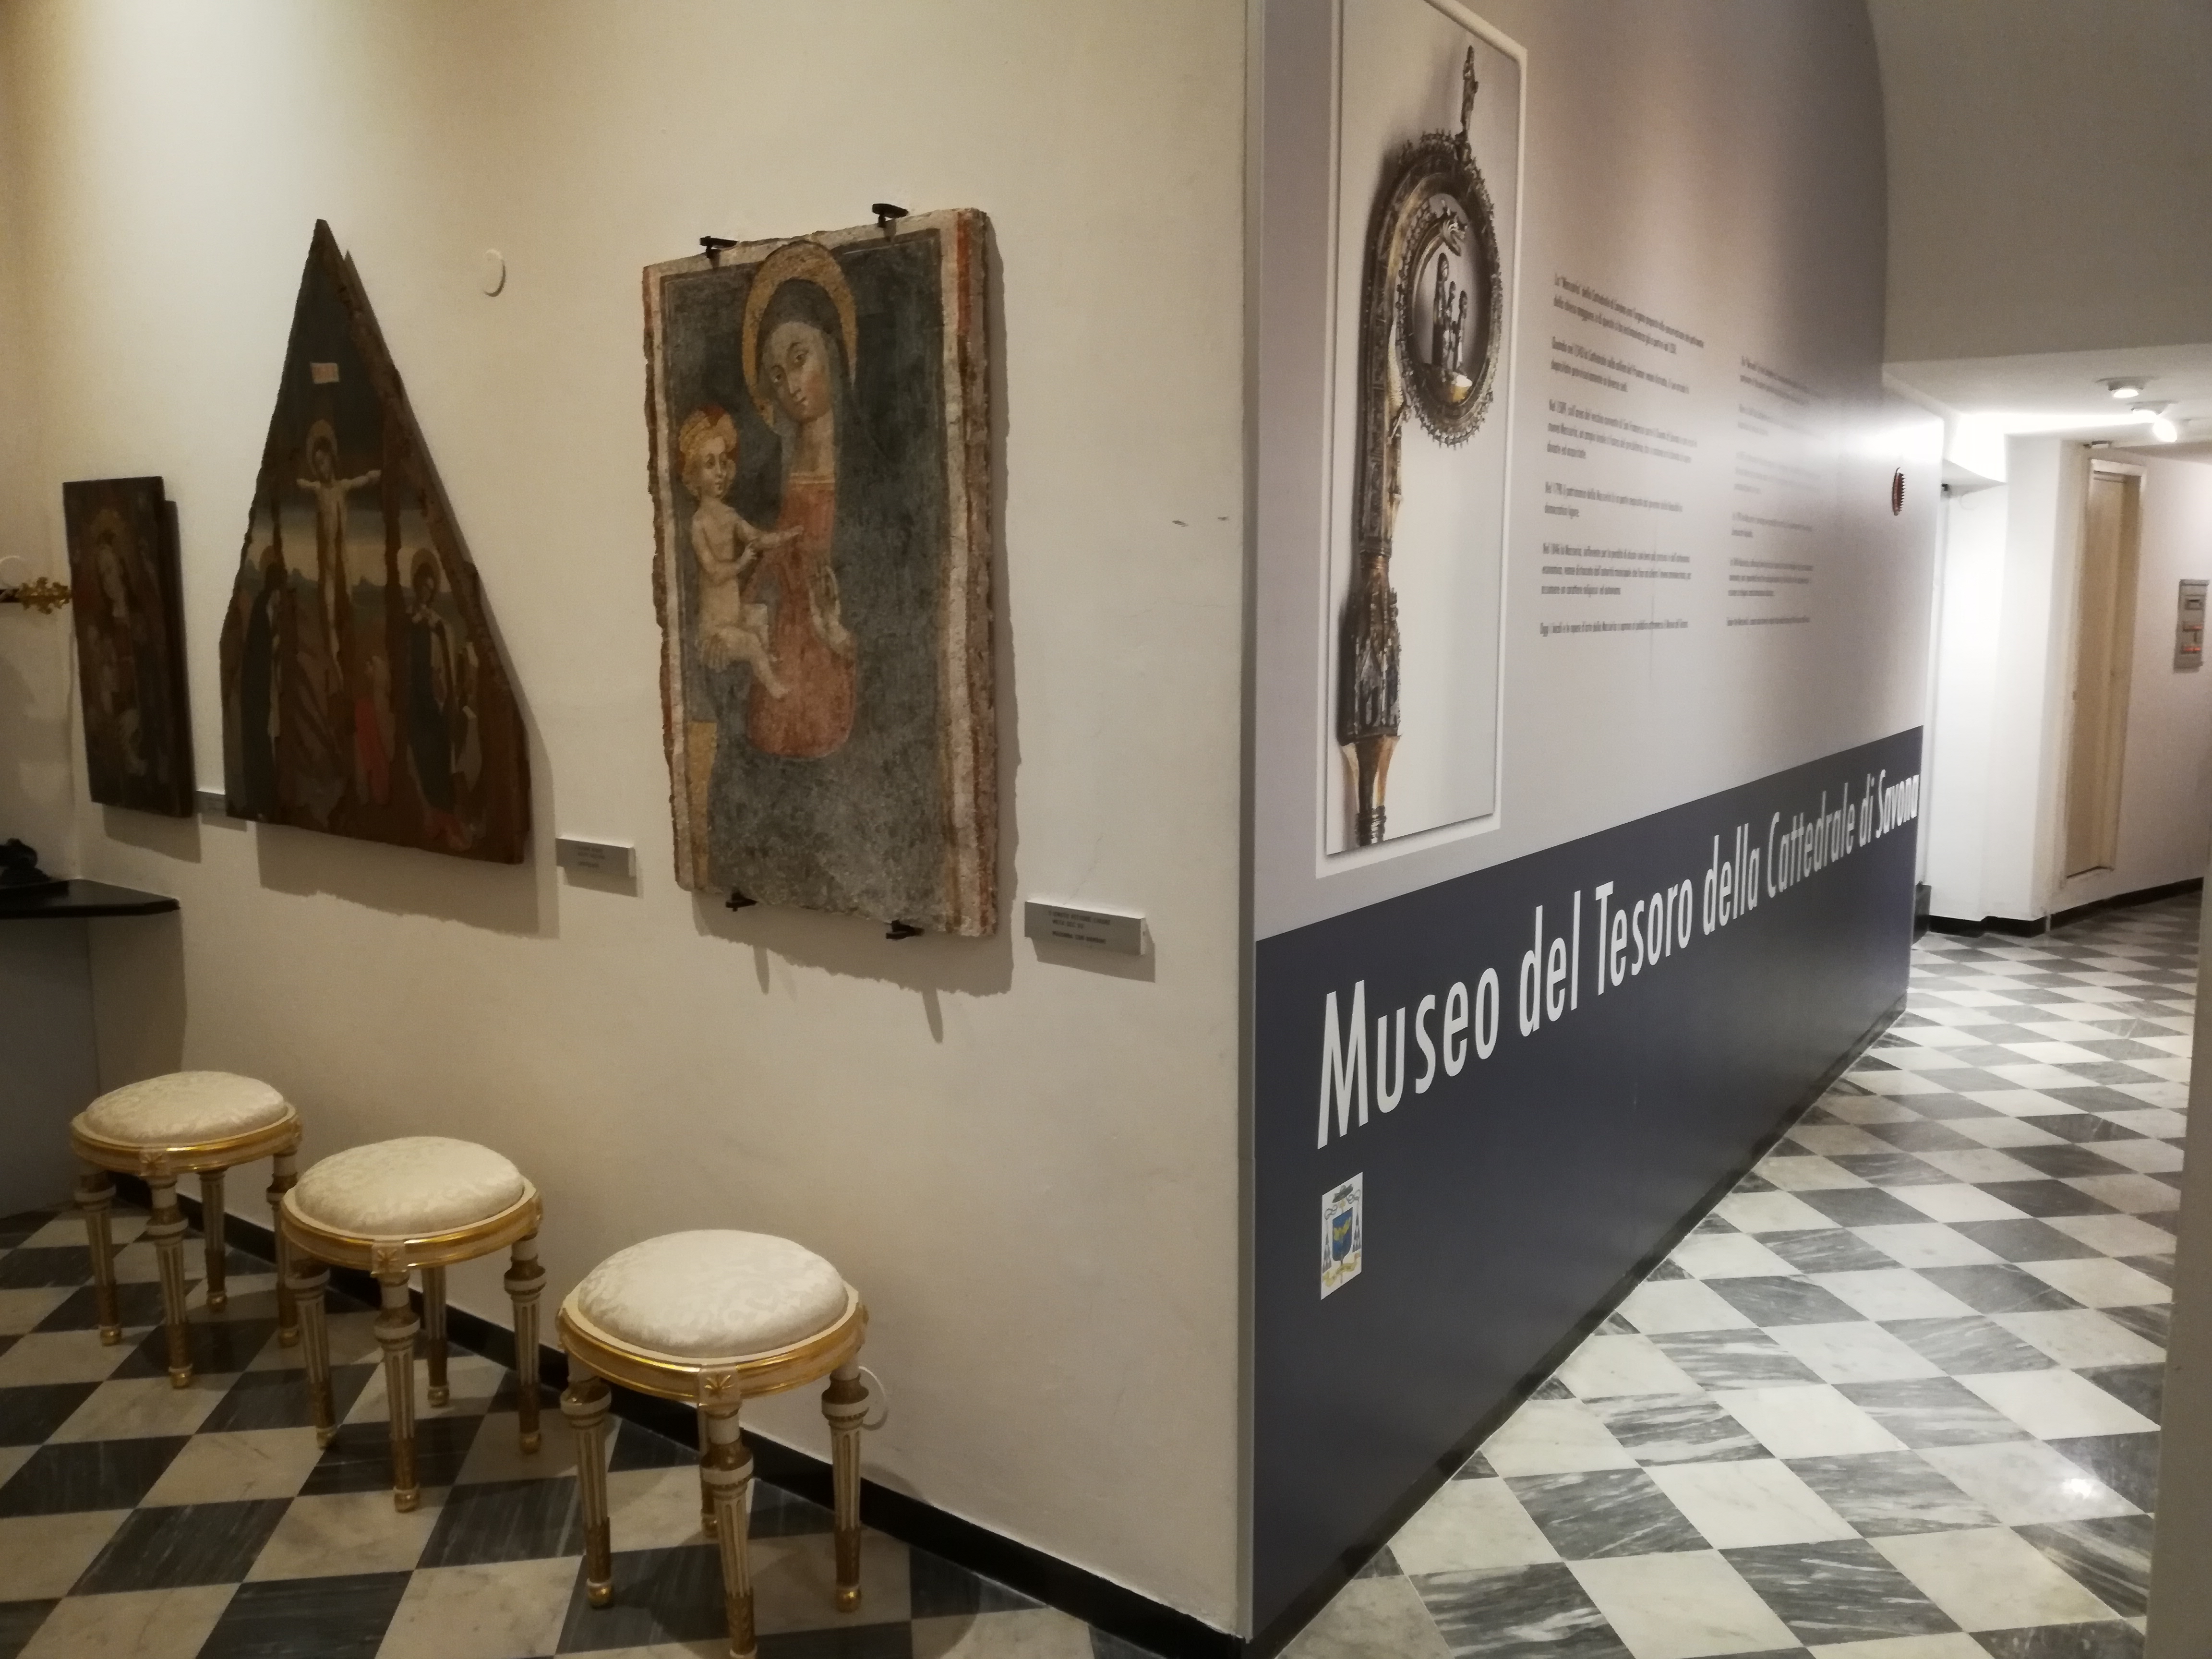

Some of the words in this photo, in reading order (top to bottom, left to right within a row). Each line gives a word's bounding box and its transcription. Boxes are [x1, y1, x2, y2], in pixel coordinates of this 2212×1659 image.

[1318, 968, 1499, 1149] Museo
[1519, 890, 1581, 1037] del
[1596, 879, 1693, 996] Tesoro
[1703, 823, 1760, 936] della
[1767, 782, 1855, 898] Cattedrale
[1859, 773, 1875, 847] di
[1875, 769, 1920, 838] Savona
